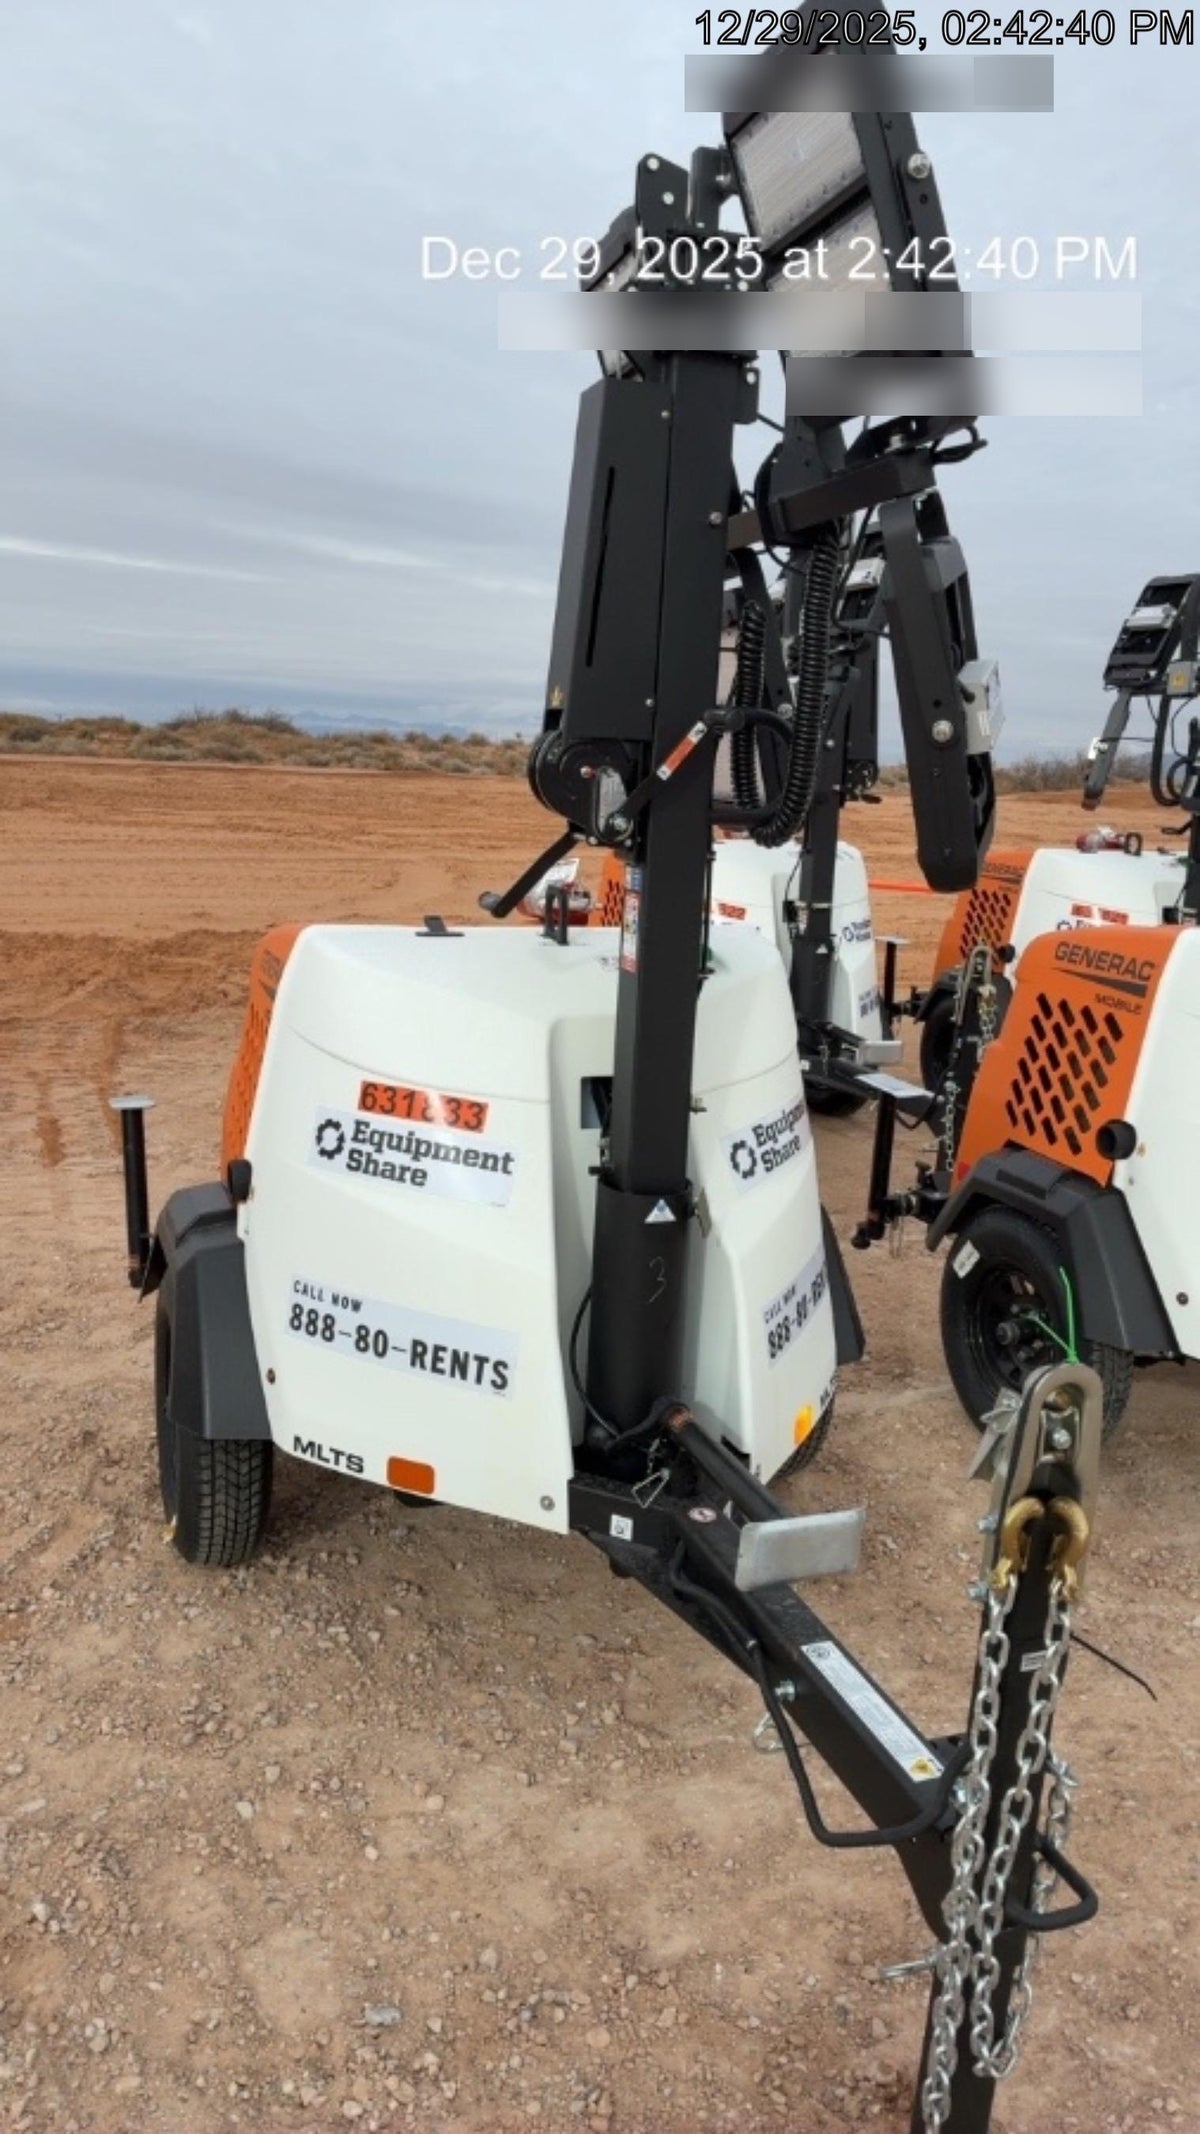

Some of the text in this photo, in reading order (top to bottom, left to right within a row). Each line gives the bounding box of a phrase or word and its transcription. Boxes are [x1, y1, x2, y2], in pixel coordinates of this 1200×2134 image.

[1055, 941, 1155, 982] GENERAC
[350, 1119, 514, 1175] Equipment
[346, 1148, 428, 1187] Share
[293, 1280, 363, 1313] CALL NOW
[289, 1303, 510, 1391] 888-80-RENTS
[293, 1435, 364, 1473] MLTS
